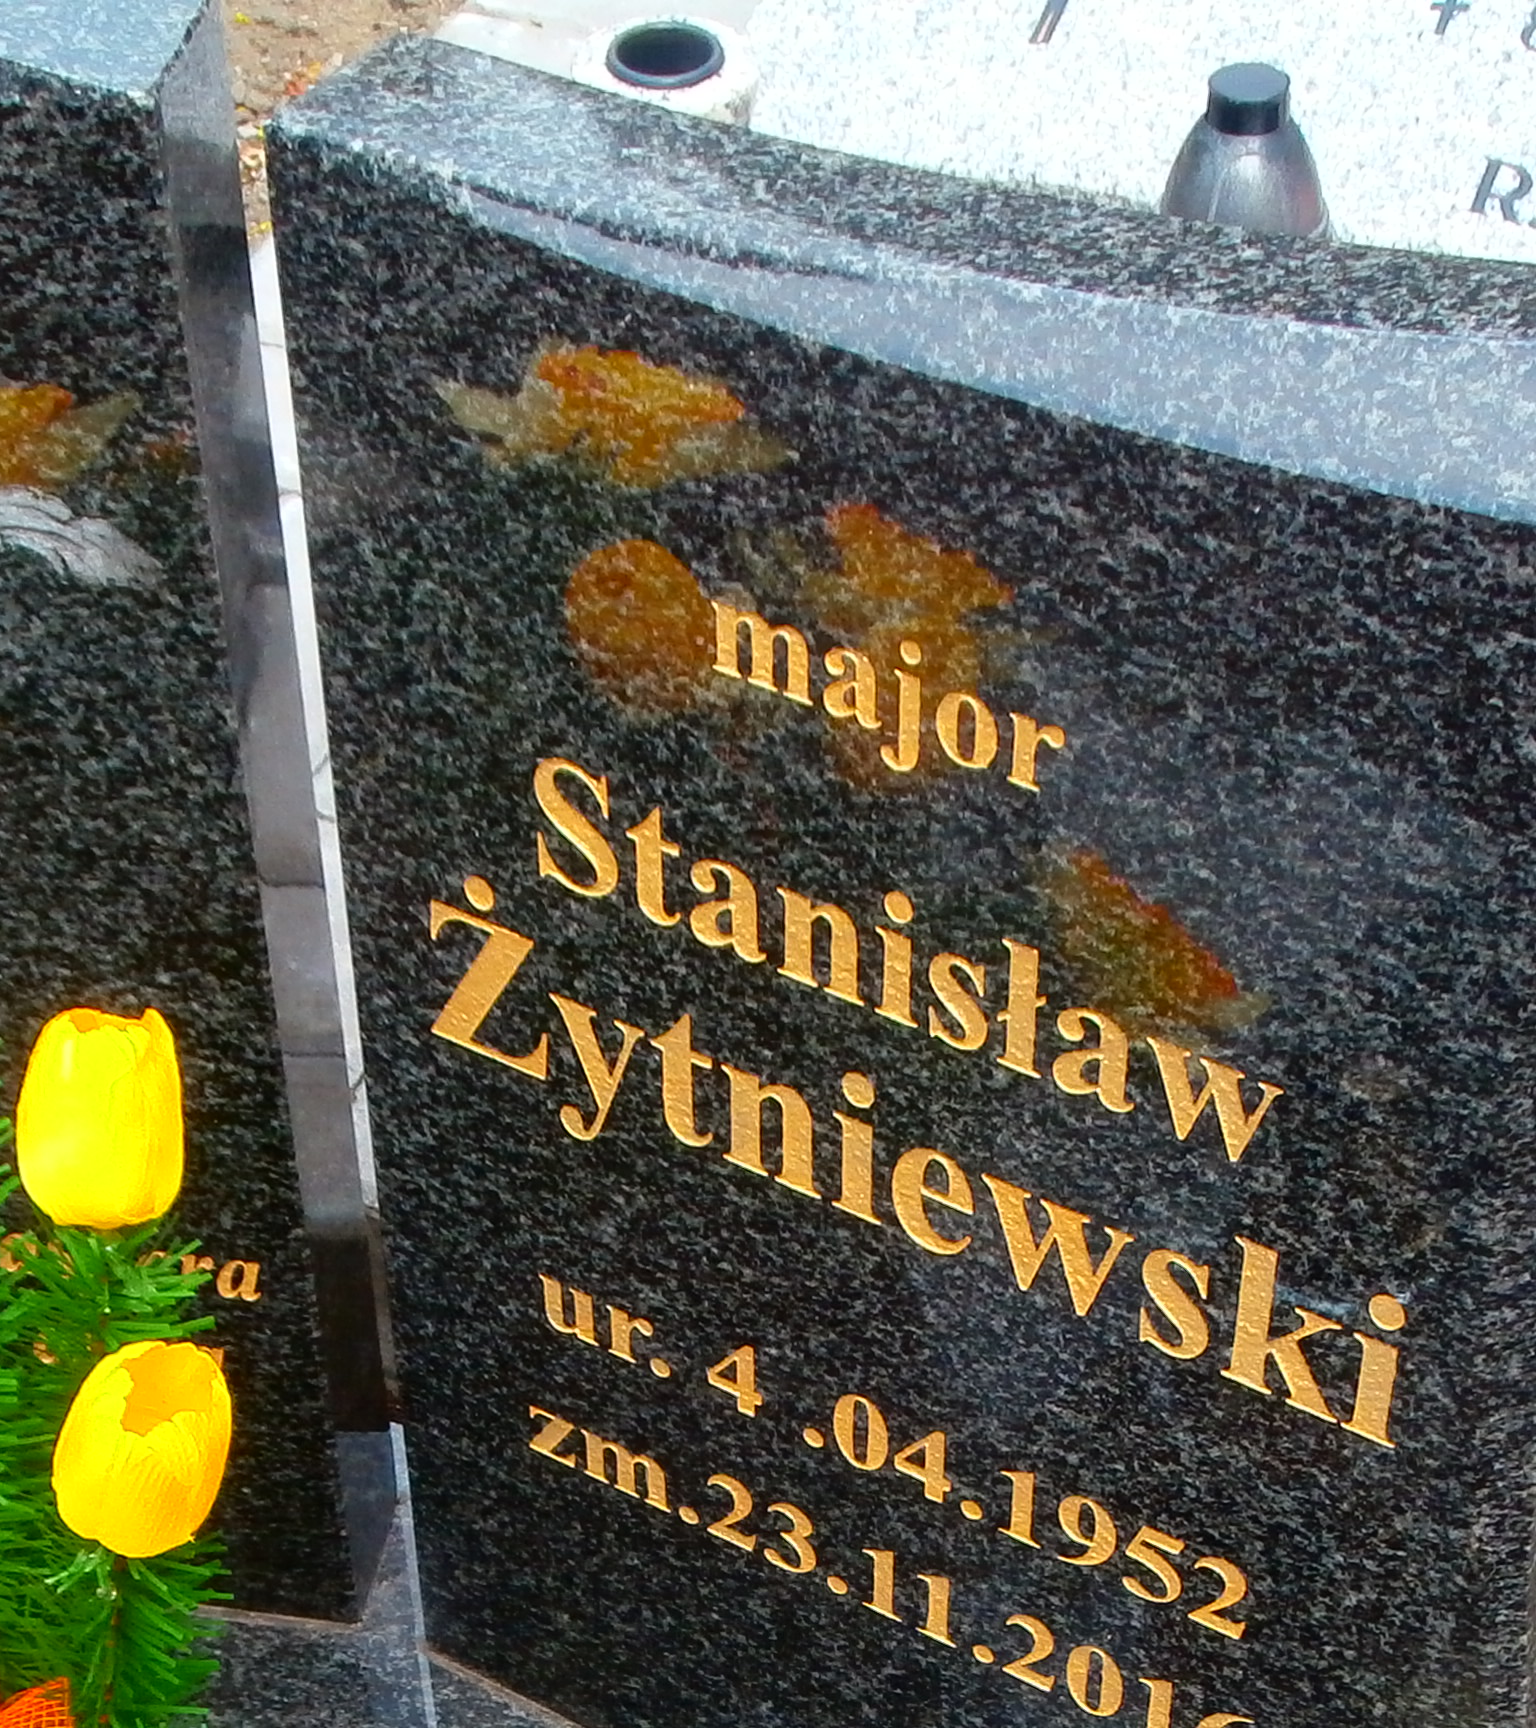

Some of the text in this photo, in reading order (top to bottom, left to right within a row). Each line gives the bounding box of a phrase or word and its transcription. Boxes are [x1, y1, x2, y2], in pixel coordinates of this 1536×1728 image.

[711, 600, 1064, 793] major
[532, 755, 1284, 1163] Stanisław
[429, 874, 1407, 1447] Żytniewski
[537, 1272, 672, 1379] ur.
